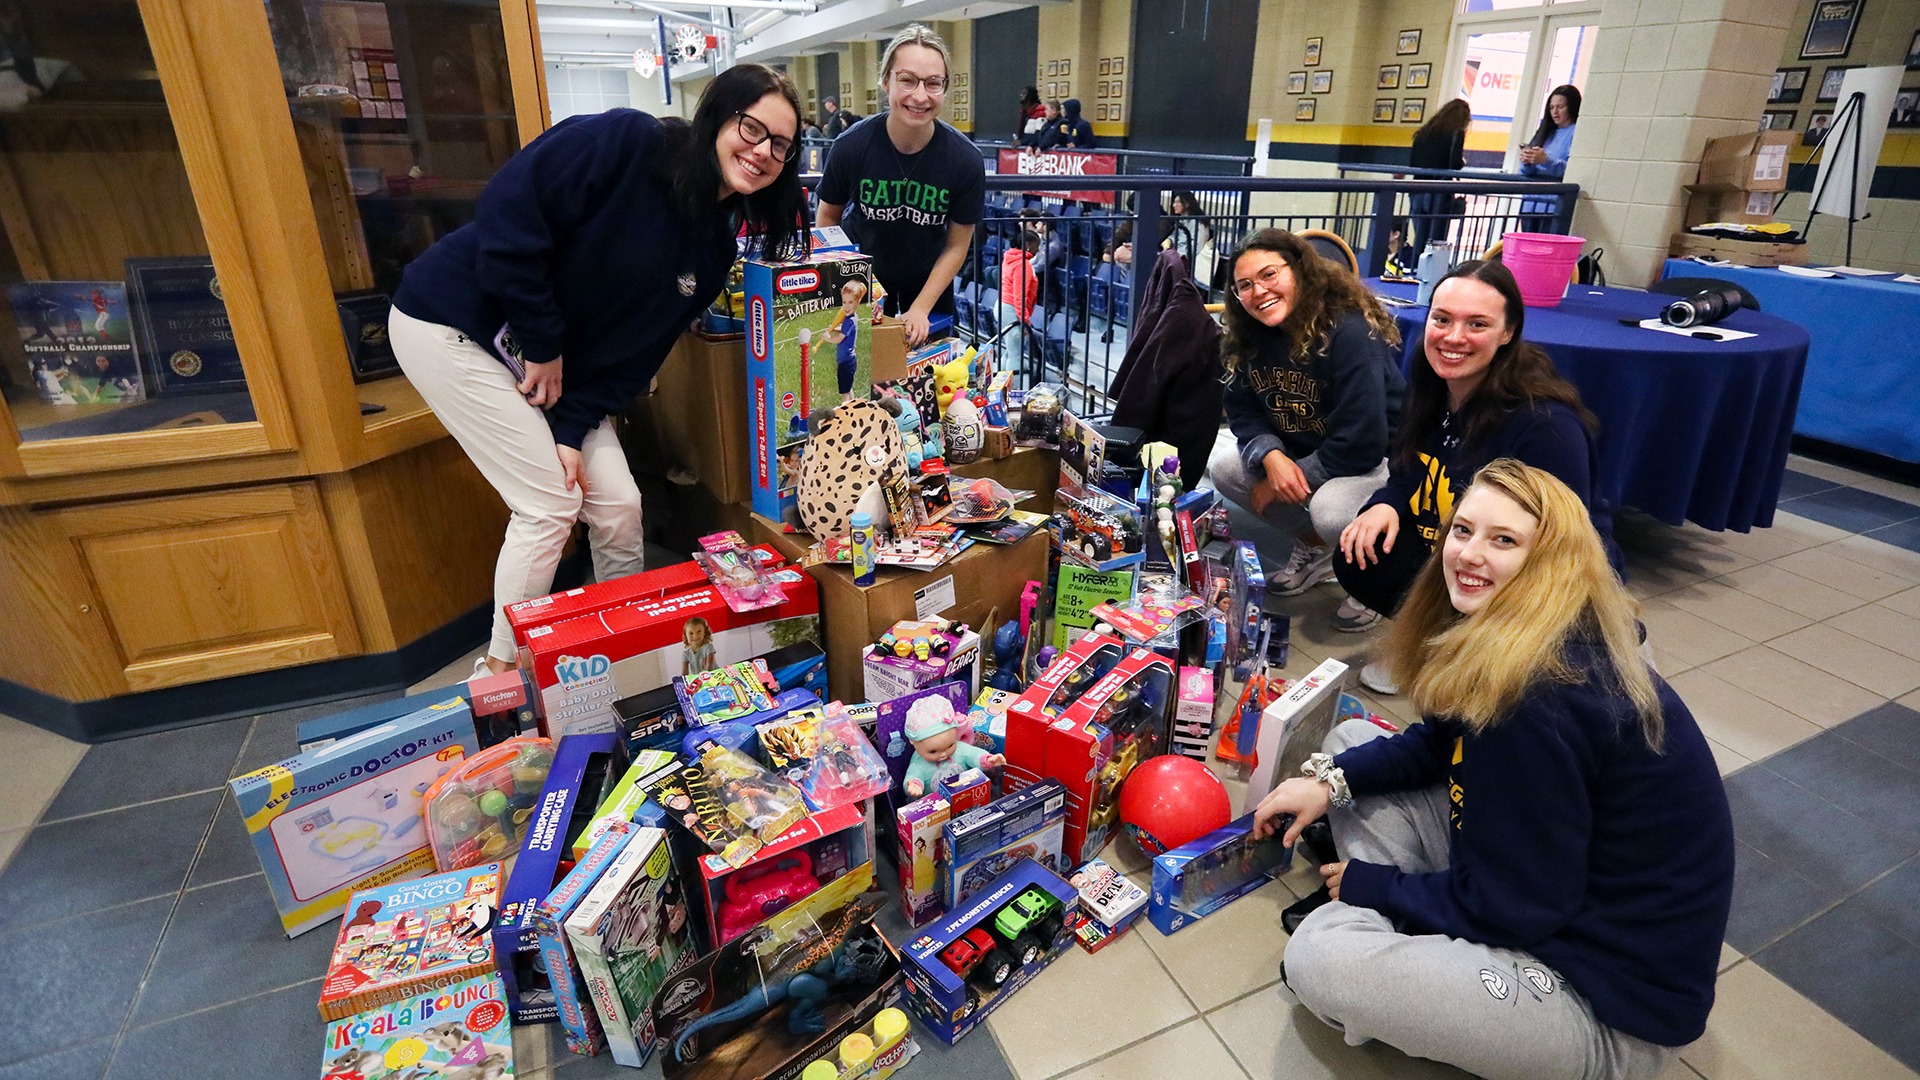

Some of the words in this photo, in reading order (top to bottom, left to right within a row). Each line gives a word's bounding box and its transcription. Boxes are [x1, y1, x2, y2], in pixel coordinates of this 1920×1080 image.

[859, 178, 949, 214] GATORS
[859, 202, 946, 226] BASKETBALL
[842, 265, 850, 274] GO
[781, 278, 798, 288] little
[799, 277, 816, 286] tikes
[754, 301, 762, 328] little
[788, 299, 819, 320] BATTER
[754, 328, 762, 354] tikes
[759, 436, 767, 462] T-Ball
[1070, 595, 1084, 606] 8+
[558, 656, 609, 685] KID
[943, 646, 979, 678] BEARS
[483, 689, 518, 704] Kitchen
[559, 693, 589, 709] Baby
[592, 685, 617, 699] Doll
[555, 701, 603, 721] Stroller
[847, 703, 877, 717] ORRY
[440, 750, 450, 762] 7
[265, 772, 348, 810] ELECTRONIC
[350, 738, 428, 778] DOCTOR
[432, 730, 455, 745] KIT
[1002, 771, 1035, 785] Constructi
[971, 784, 988, 800] 100
[681, 767, 728, 844] NARUTO
[528, 791, 557, 850] TRANSPORTER
[540, 808, 562, 851] CARRYING
[555, 788, 569, 808] CASE
[789, 827, 808, 838] Set
[351, 879, 371, 891] Light
[380, 864, 402, 879] Sound
[381, 877, 391, 887] Up
[392, 867, 413, 879] Blood
[398, 884, 421, 893] Cozy
[423, 877, 456, 887] Cottage
[386, 881, 463, 908] BINGO
[958, 900, 992, 924] MONSTER
[988, 882, 1014, 902] TRUCKS
[1096, 882, 1123, 907] DEAL
[500, 901, 519, 926] PLAY
[518, 943, 540, 951] VEHICL
[917, 941, 944, 960] VEHICLES
[373, 990, 395, 999] Cozy
[400, 974, 465, 999] BINGO
[989, 985, 1020, 1011] MONSTER
[1019, 966, 1042, 988] TRUCKS
[420, 980, 499, 1021] BOUNCE
[517, 1006, 558, 1016] TRANSPOR
[593, 977, 619, 1022] MONOPOLY
[518, 1012, 556, 1021] CARRYING
[399, 1046, 413, 1062] 5
[462, 1045, 479, 1061] 4
[774, 1029, 849, 1080] ARCHARODONTOSAURUS
